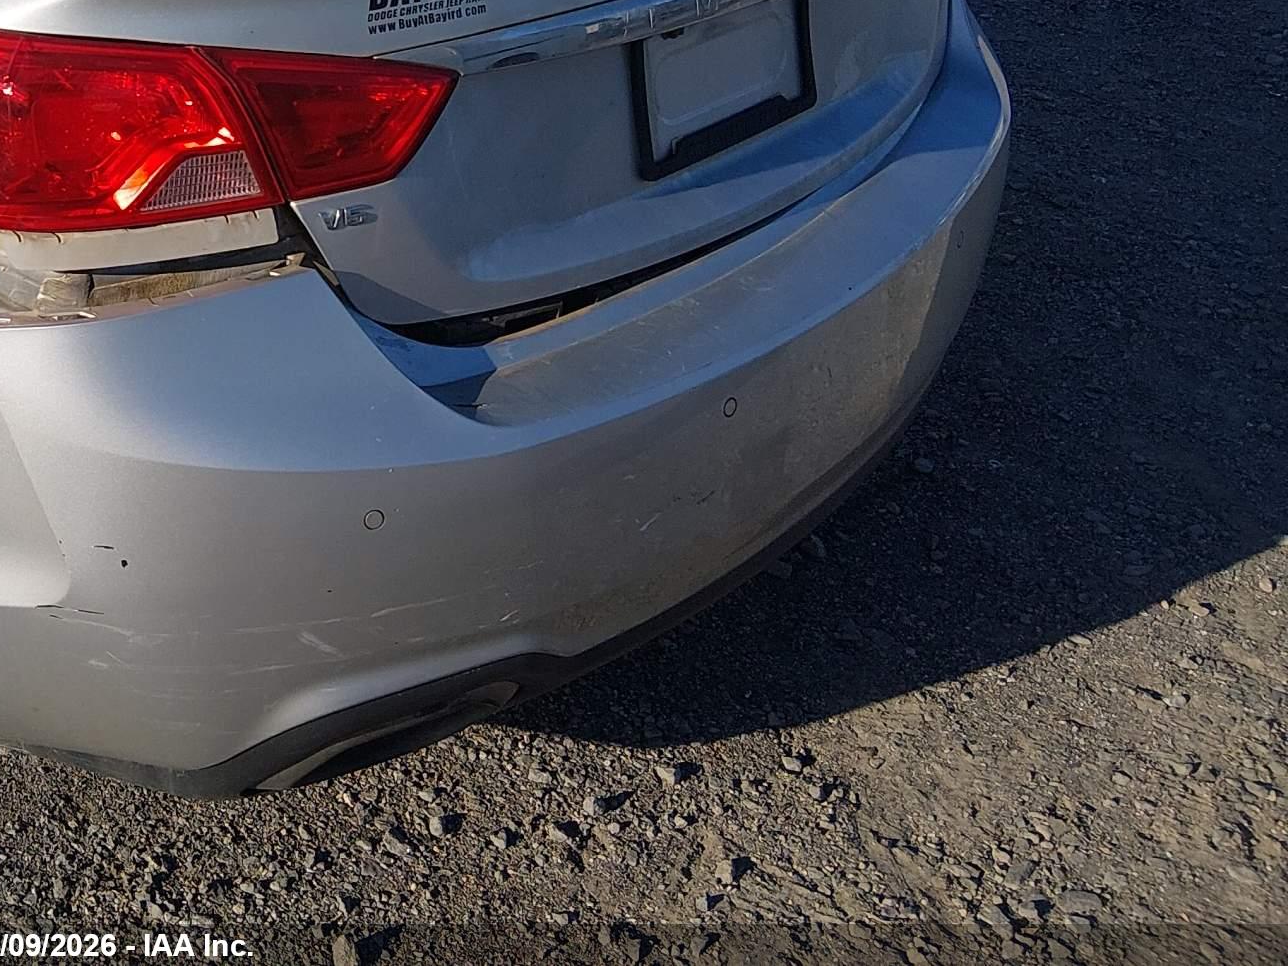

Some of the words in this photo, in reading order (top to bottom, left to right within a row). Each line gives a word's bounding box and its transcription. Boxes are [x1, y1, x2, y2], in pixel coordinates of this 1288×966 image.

[367, 10, 398, 22] DODGE
[399, 1, 445, 17] CHRYSLER
[317, 204, 378, 231] V6
